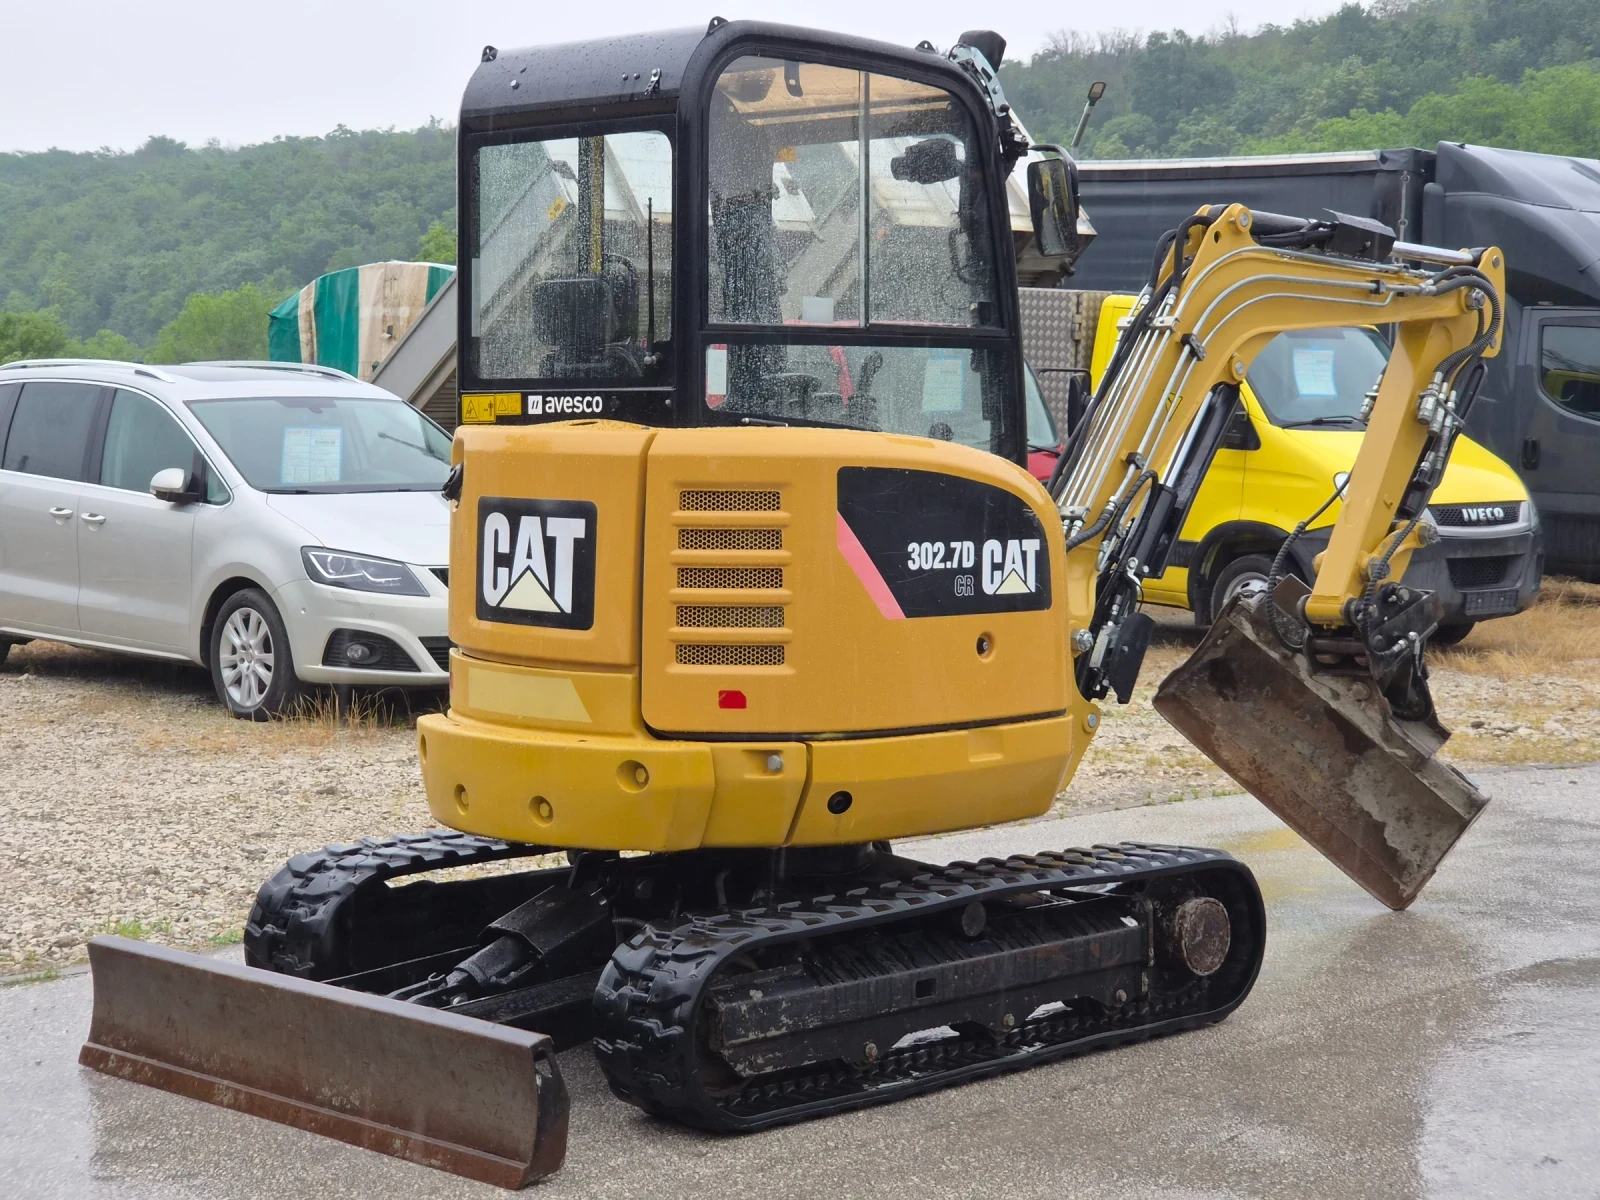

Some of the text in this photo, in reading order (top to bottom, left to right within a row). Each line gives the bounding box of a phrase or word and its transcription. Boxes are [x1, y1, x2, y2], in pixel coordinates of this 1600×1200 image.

[545, 395, 603, 413] avesco
[1461, 507, 1504, 521] IVECO
[482, 511, 586, 614] CAT
[907, 540, 975, 570] 302.7D
[981, 538, 1041, 595] CAT
[954, 574, 974, 596] CR
